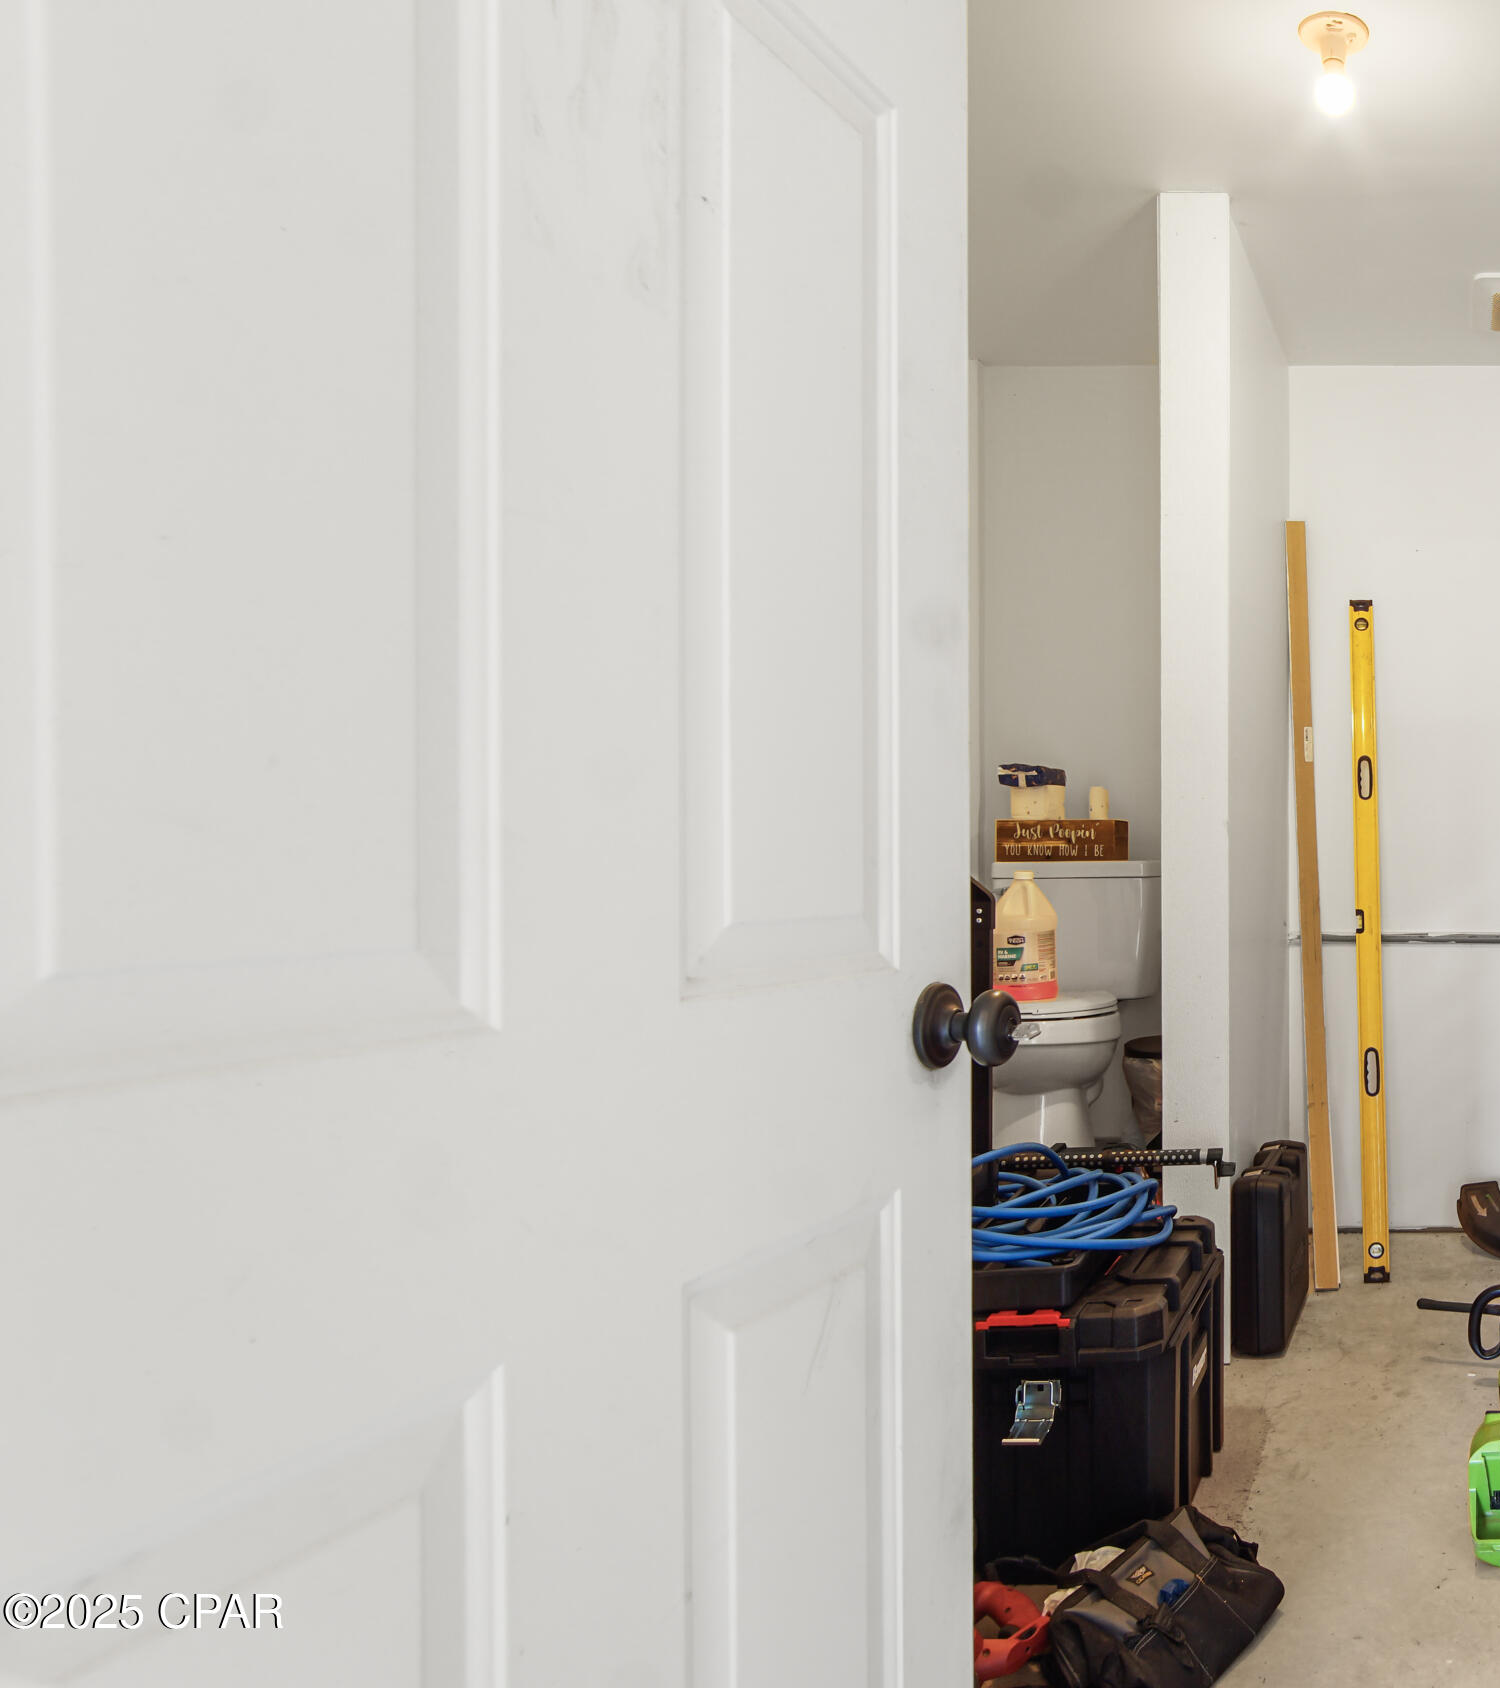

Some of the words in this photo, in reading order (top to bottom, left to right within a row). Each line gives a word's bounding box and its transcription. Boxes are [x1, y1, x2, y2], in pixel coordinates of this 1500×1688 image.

[1013, 821, 1042, 840] Just
[1004, 844, 1021, 856] YOU
[1027, 844, 1053, 857] KNOW
[1059, 844, 1079, 857] HOW
[1094, 844, 1105, 857] BE
